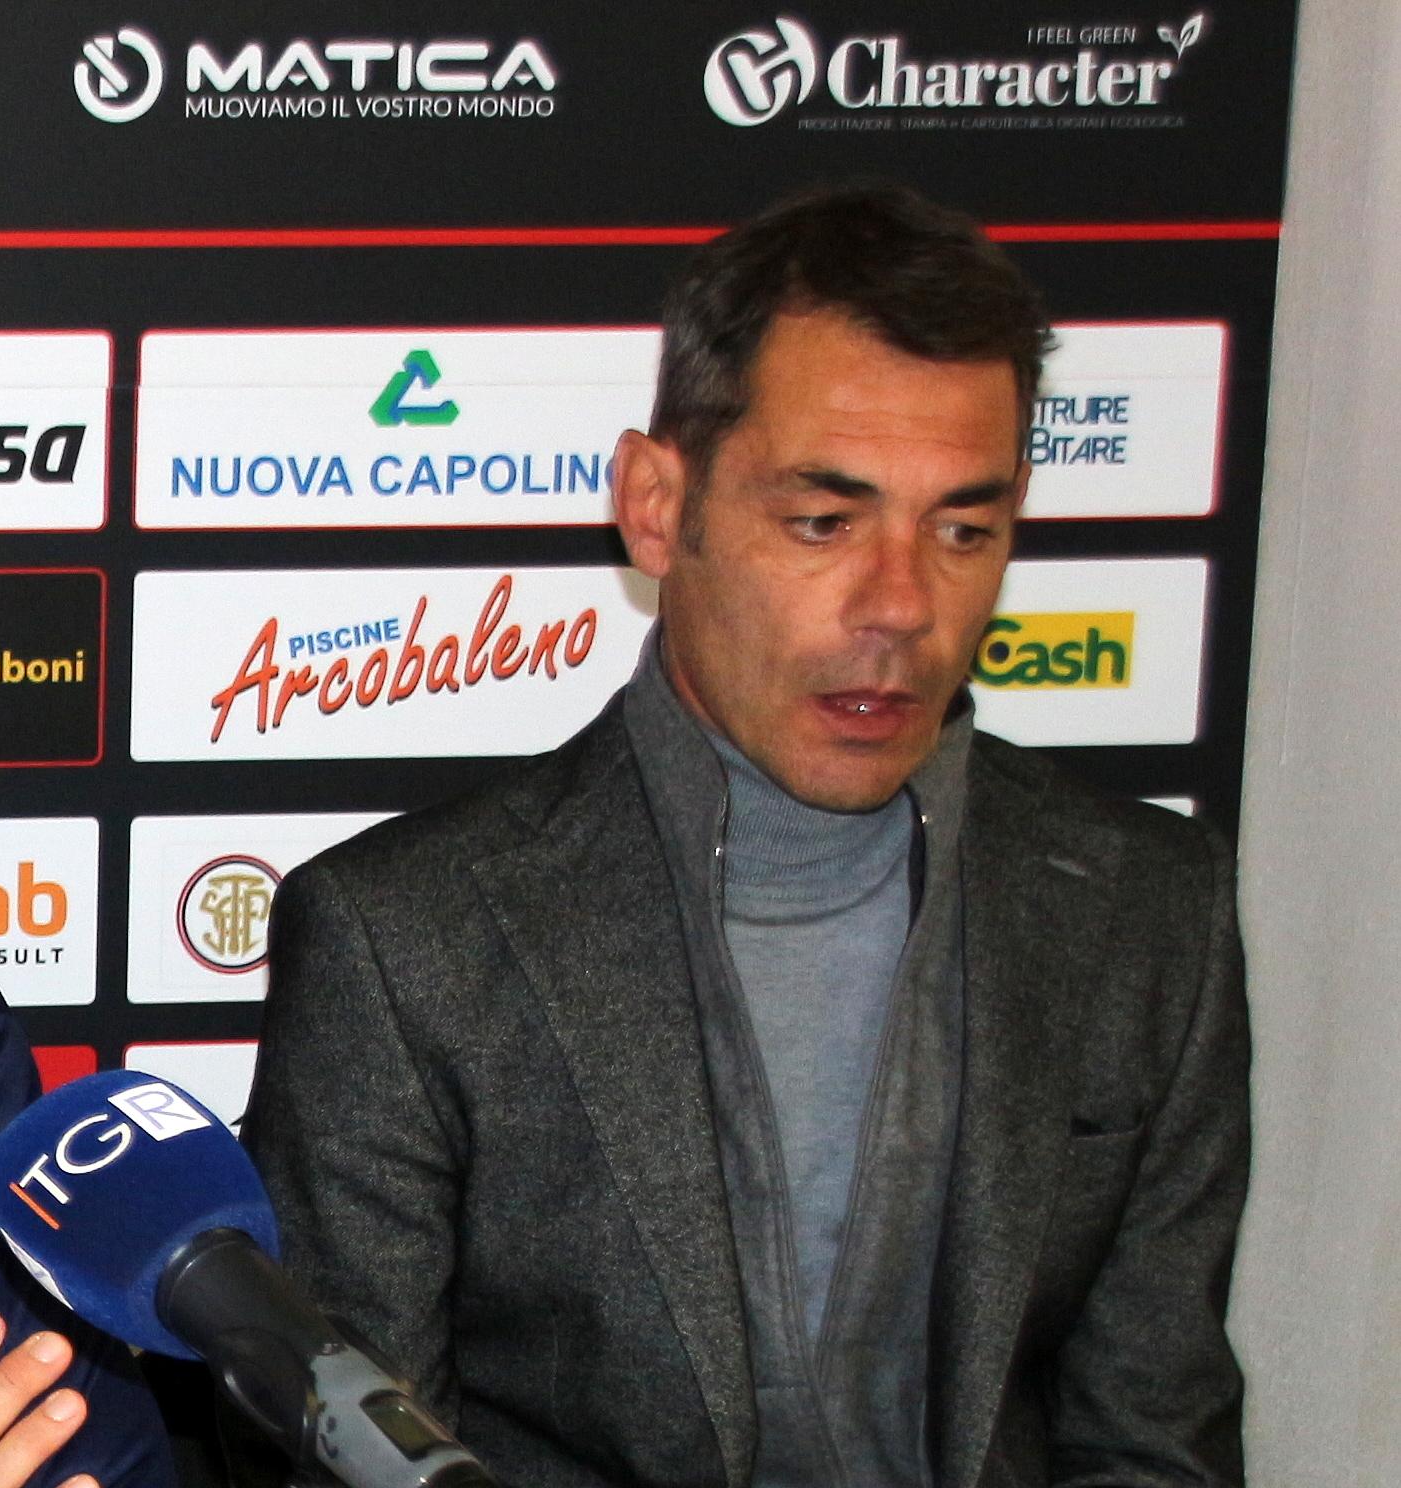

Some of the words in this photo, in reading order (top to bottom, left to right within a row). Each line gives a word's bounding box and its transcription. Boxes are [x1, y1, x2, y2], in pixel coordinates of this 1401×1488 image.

[1036, 28, 1076, 44] FEEL
[1080, 27, 1137, 44] GREEN
[184, 40, 555, 93] MATICA
[827, 37, 1172, 108] Character
[185, 97, 325, 119] MUOVIAMO
[331, 98, 352, 118] IL
[356, 97, 452, 119] VOSTRO
[458, 97, 555, 118] MONDO
[170, 454, 354, 498] NUOVA
[369, 452, 614, 496] CAPOLIN
[210, 574, 597, 744] Arcobaleno
[288, 617, 401, 659] PISCINE
